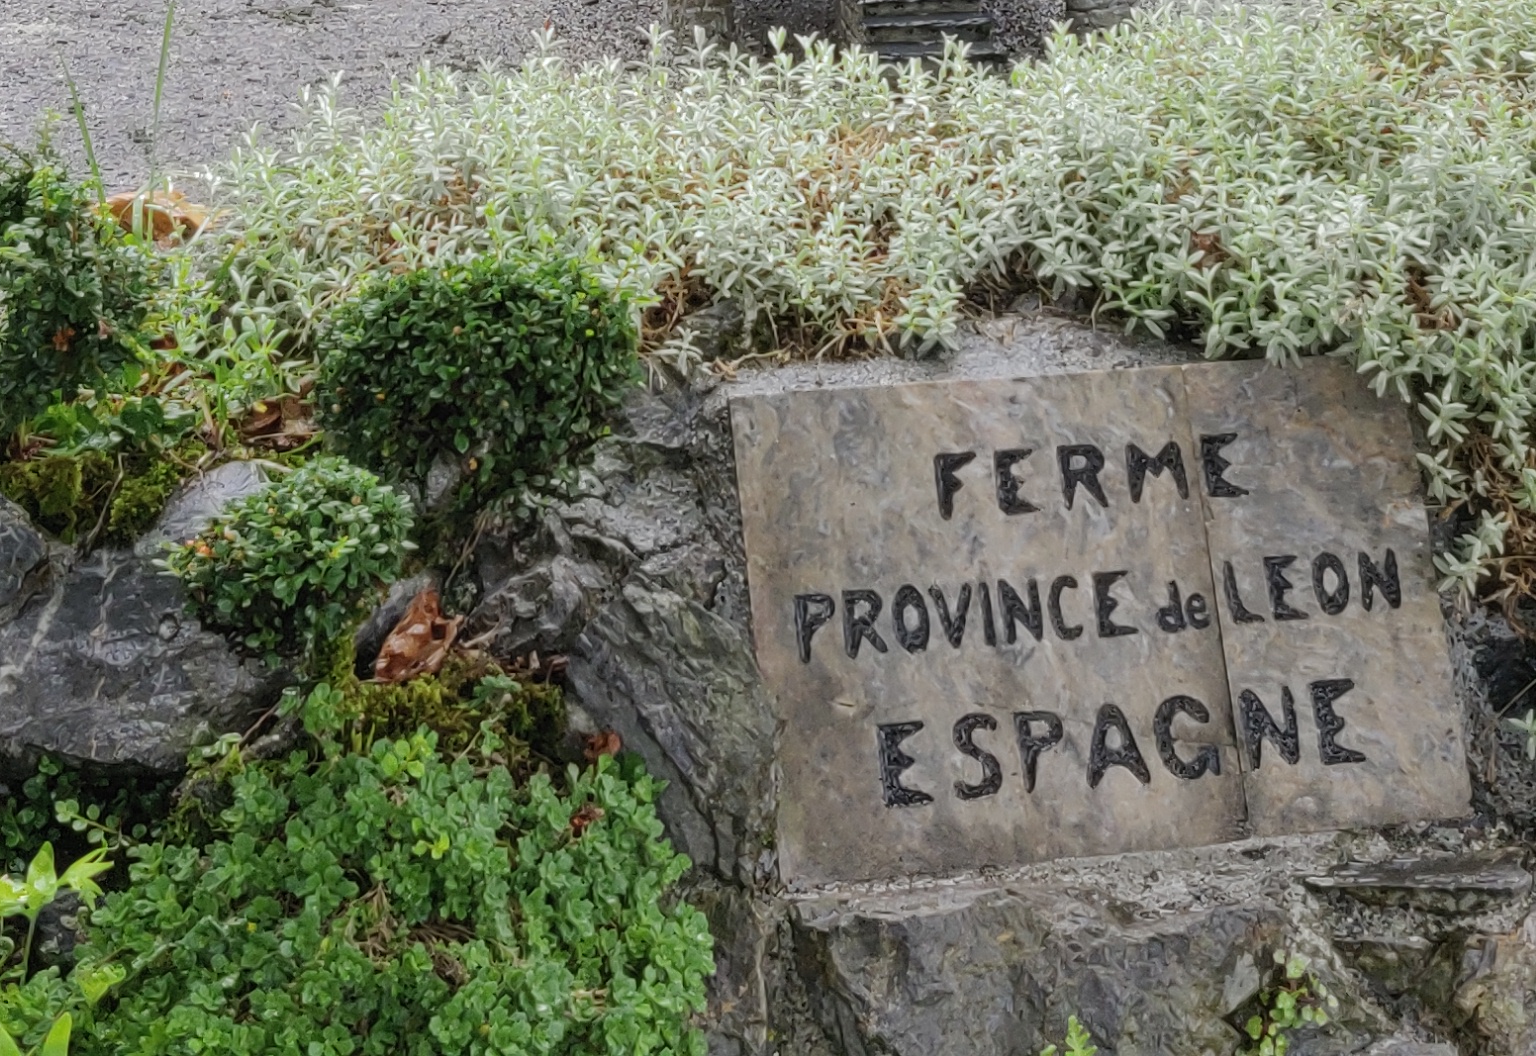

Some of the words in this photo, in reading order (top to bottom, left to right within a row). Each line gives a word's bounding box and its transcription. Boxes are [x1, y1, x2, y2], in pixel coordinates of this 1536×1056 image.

[933, 432, 1250, 520] FERME
[793, 570, 1139, 663] PROVINCE
[1155, 580, 1212, 634] de
[1222, 548, 1402, 626] LEON
[877, 678, 1367, 808] ESPAGNE
